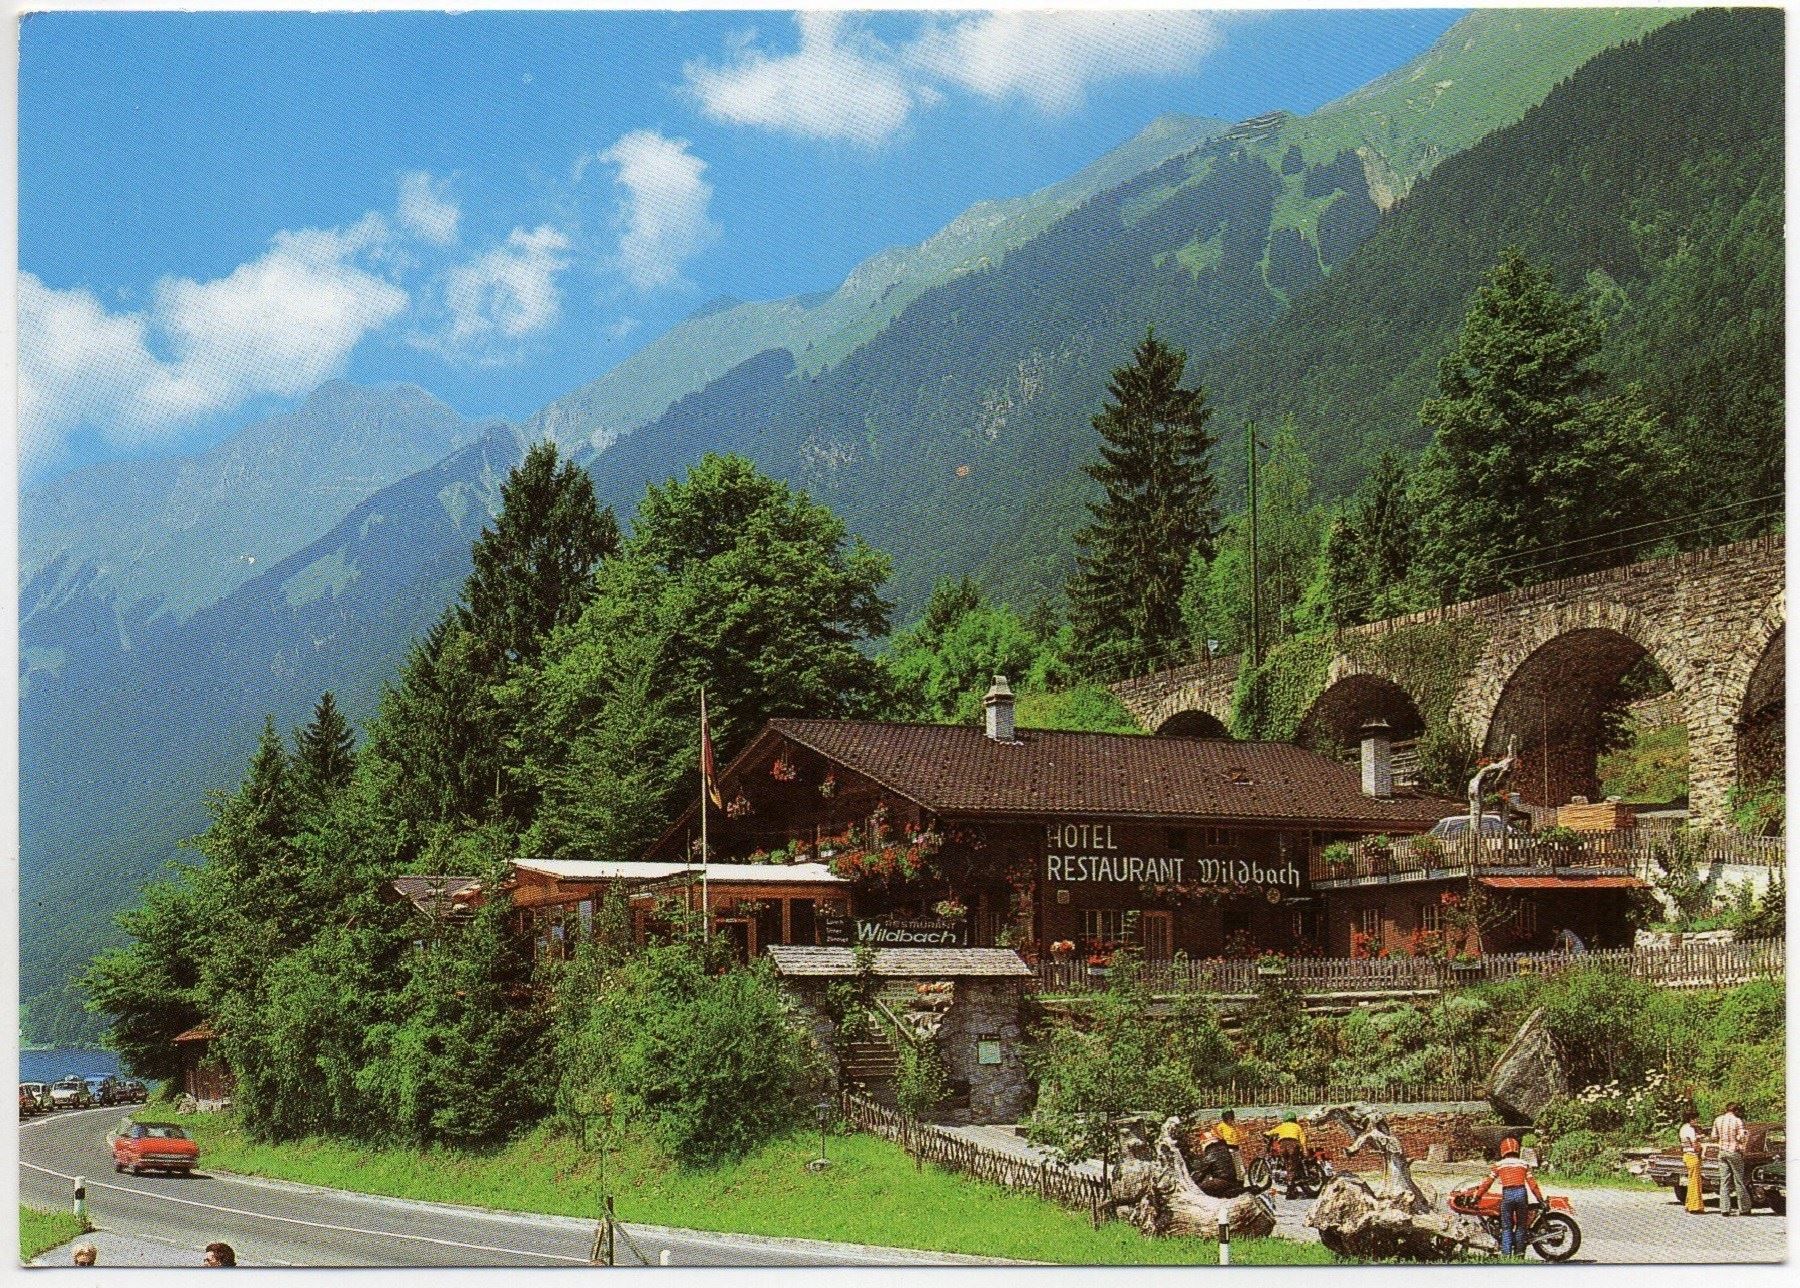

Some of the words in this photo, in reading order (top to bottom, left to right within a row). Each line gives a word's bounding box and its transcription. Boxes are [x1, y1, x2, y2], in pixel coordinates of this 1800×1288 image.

[1048, 824, 1118, 850] HOTEL
[1047, 855, 1184, 884] RESTAURANT
[1198, 857, 1300, 888] Wildbach
[855, 919, 957, 943] Wildbach
